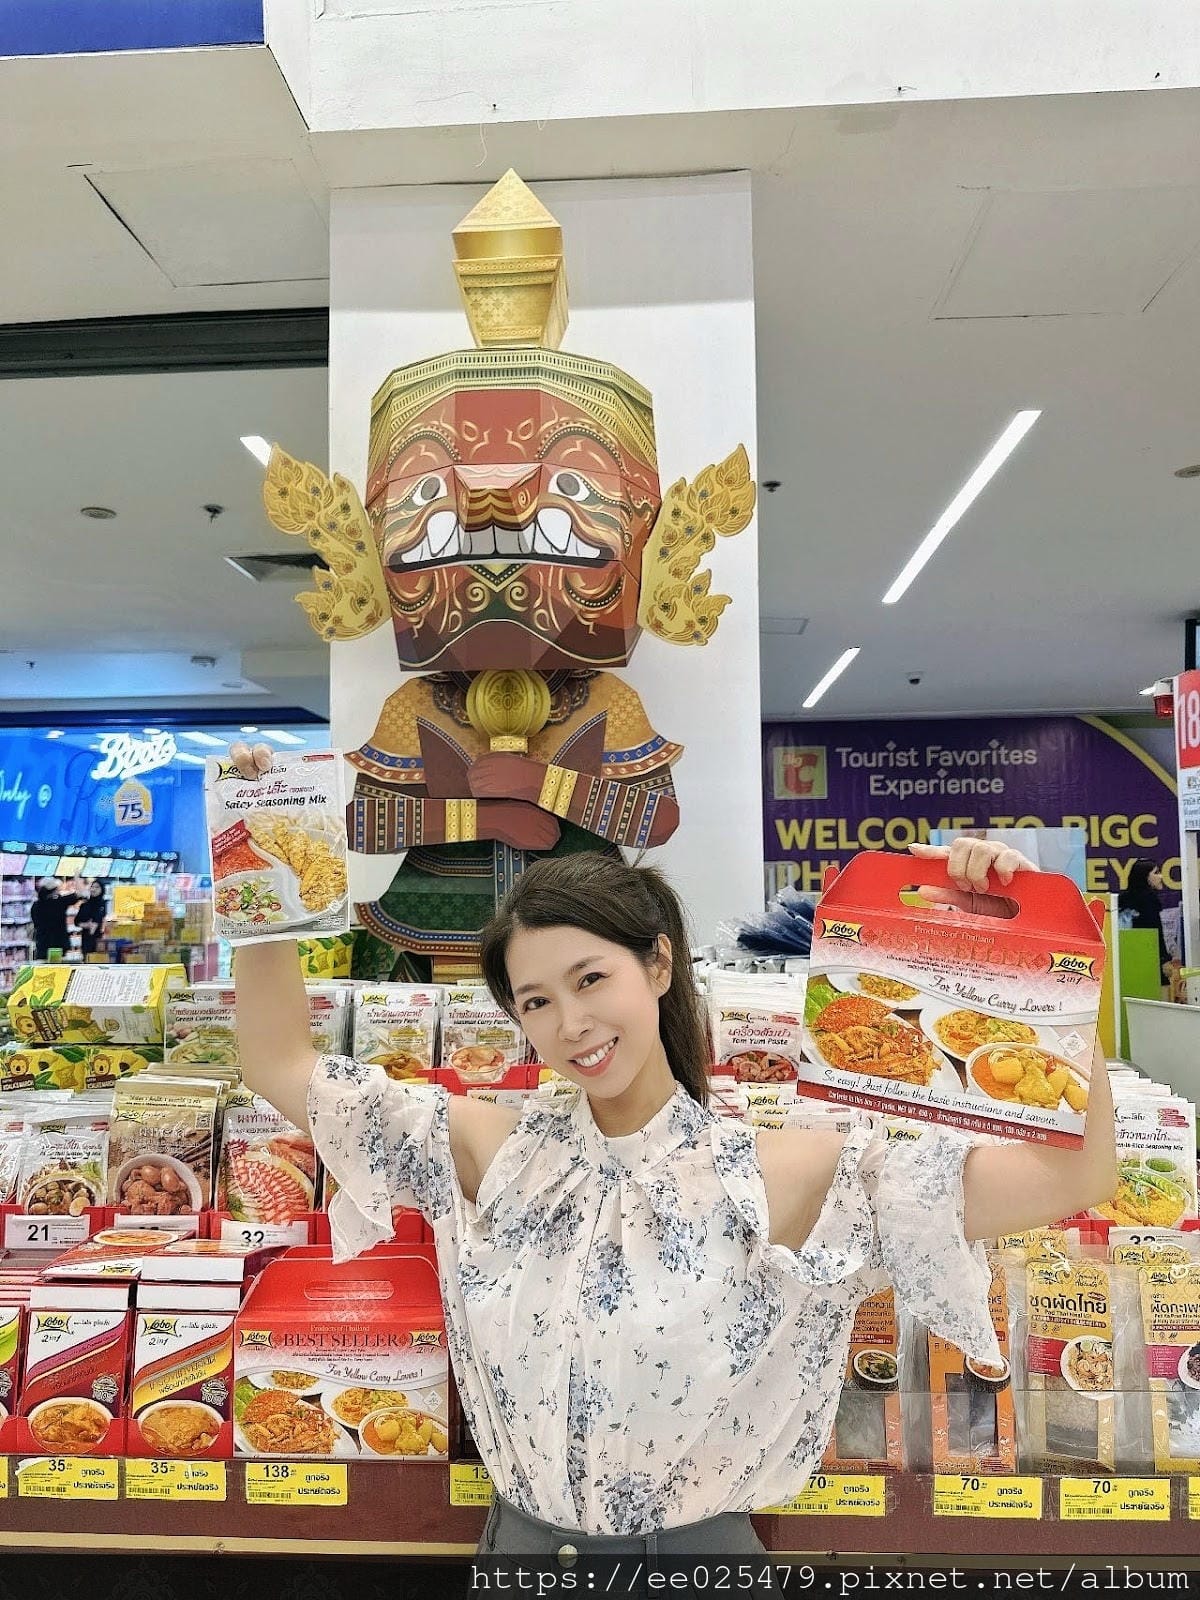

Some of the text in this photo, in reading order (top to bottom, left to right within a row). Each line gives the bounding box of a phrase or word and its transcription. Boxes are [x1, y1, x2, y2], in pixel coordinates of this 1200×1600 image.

[92, 731, 177, 780] Boots
[836, 739, 1037, 768] Tourist Favorites
[870, 768, 1003, 800] Experience
[255, 796, 306, 808] Seasoning
[309, 794, 327, 804] Mix
[118, 803, 143, 821] 75
[828, 922, 856, 938] Lobo
[1054, 956, 1087, 971] Lobo
[928, 973, 950, 992] For
[952, 982, 986, 1004] Yellow
[988, 993, 1017, 1014] Curry
[1019, 998, 1056, 1012] Lovers
[767, 1038, 788, 1046] Paste
[912, 1086, 926, 1101] the
[927, 1089, 950, 1106] basic
[951, 1098, 1002, 1115] instructions
[1004, 1106, 1026, 1119] and
[28, 1225, 48, 1241] 21
[1029, 1293, 1107, 1314] ชุดผัดไทย
[40, 1317, 66, 1329] Lobo
[147, 1319, 174, 1331] Lobo
[284, 1334, 398, 1348] BEST SELLER
[325, 1364, 342, 1377] For
[343, 1366, 367, 1381] Yellow
[369, 1369, 391, 1383] Curry
[393, 1369, 418, 1381] Lovers
[49, 1459, 66, 1472] 35
[151, 1462, 168, 1474] 35
[264, 1464, 289, 1478] 138
[472, 1466, 490, 1480] 13
[809, 1476, 826, 1489] 70
[961, 1477, 980, 1491] 70
[1092, 1480, 1111, 1494] 70
